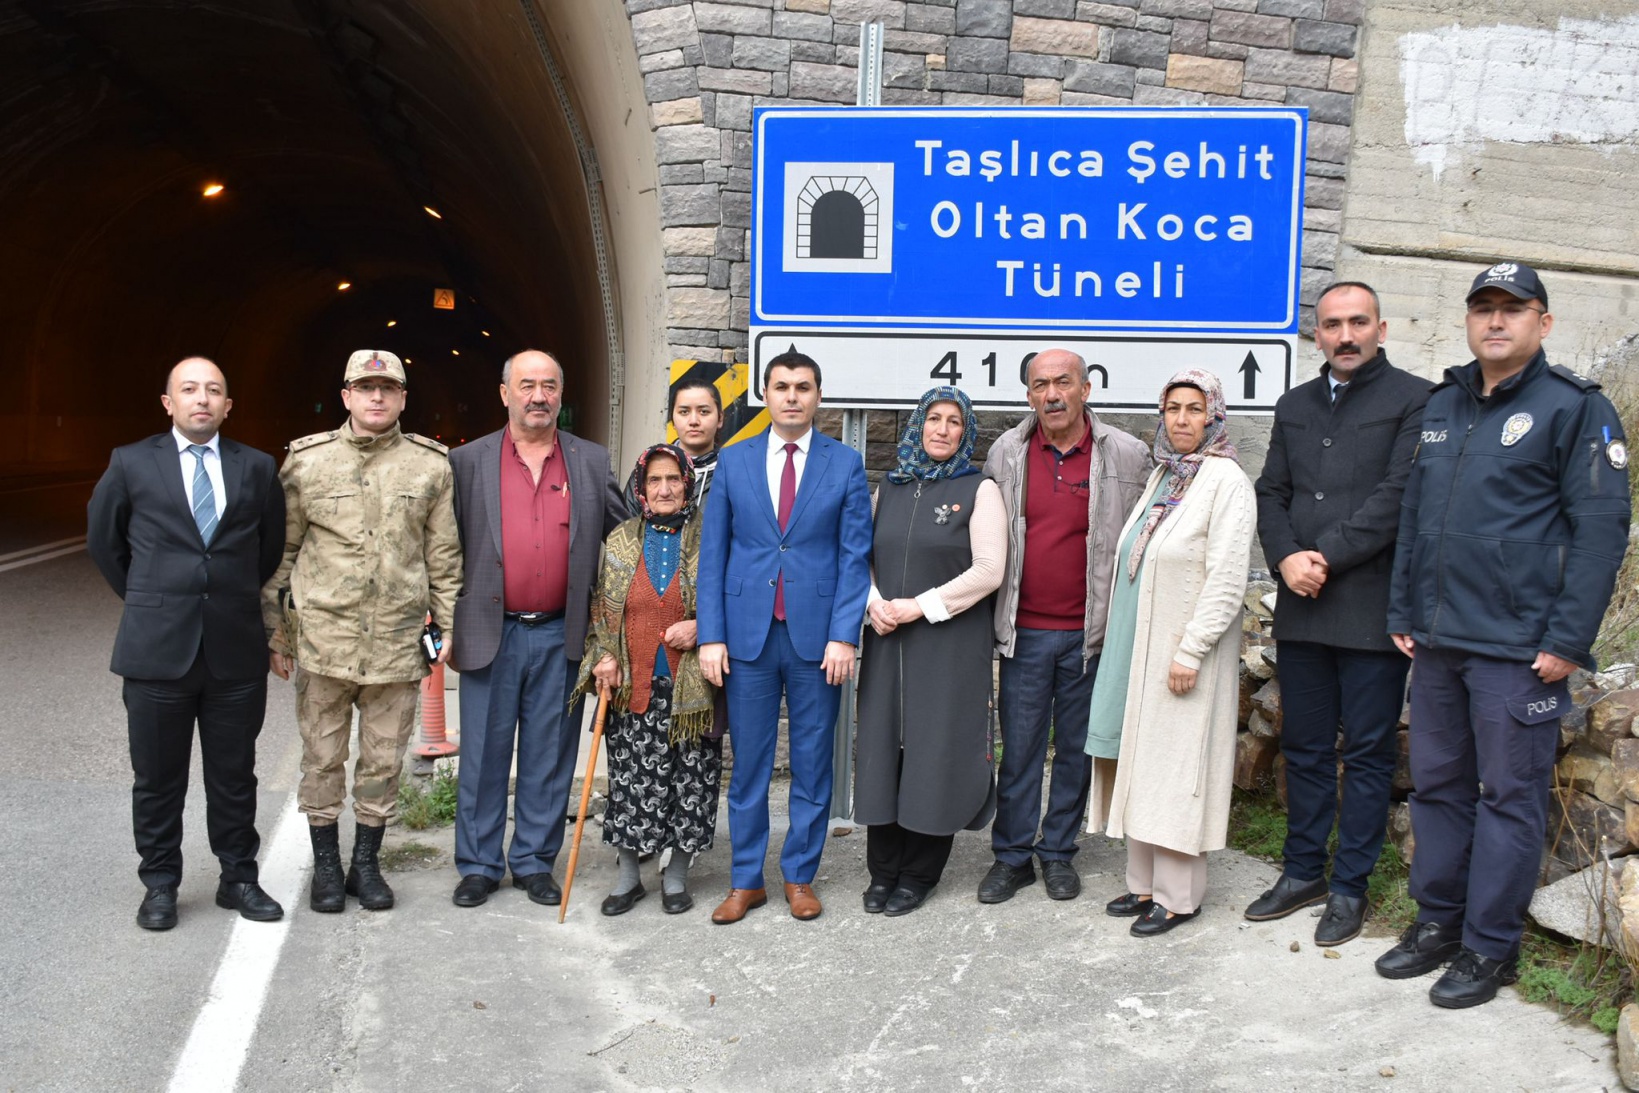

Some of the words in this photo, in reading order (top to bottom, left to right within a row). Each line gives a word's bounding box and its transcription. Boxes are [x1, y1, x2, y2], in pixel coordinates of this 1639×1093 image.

[914, 139, 1104, 182] Taşlıca
[1126, 140, 1274, 184] Şehit
[930, 200, 1088, 240] Oltan
[1117, 202, 1253, 242] Koca
[996, 260, 1184, 298] Tüneli
